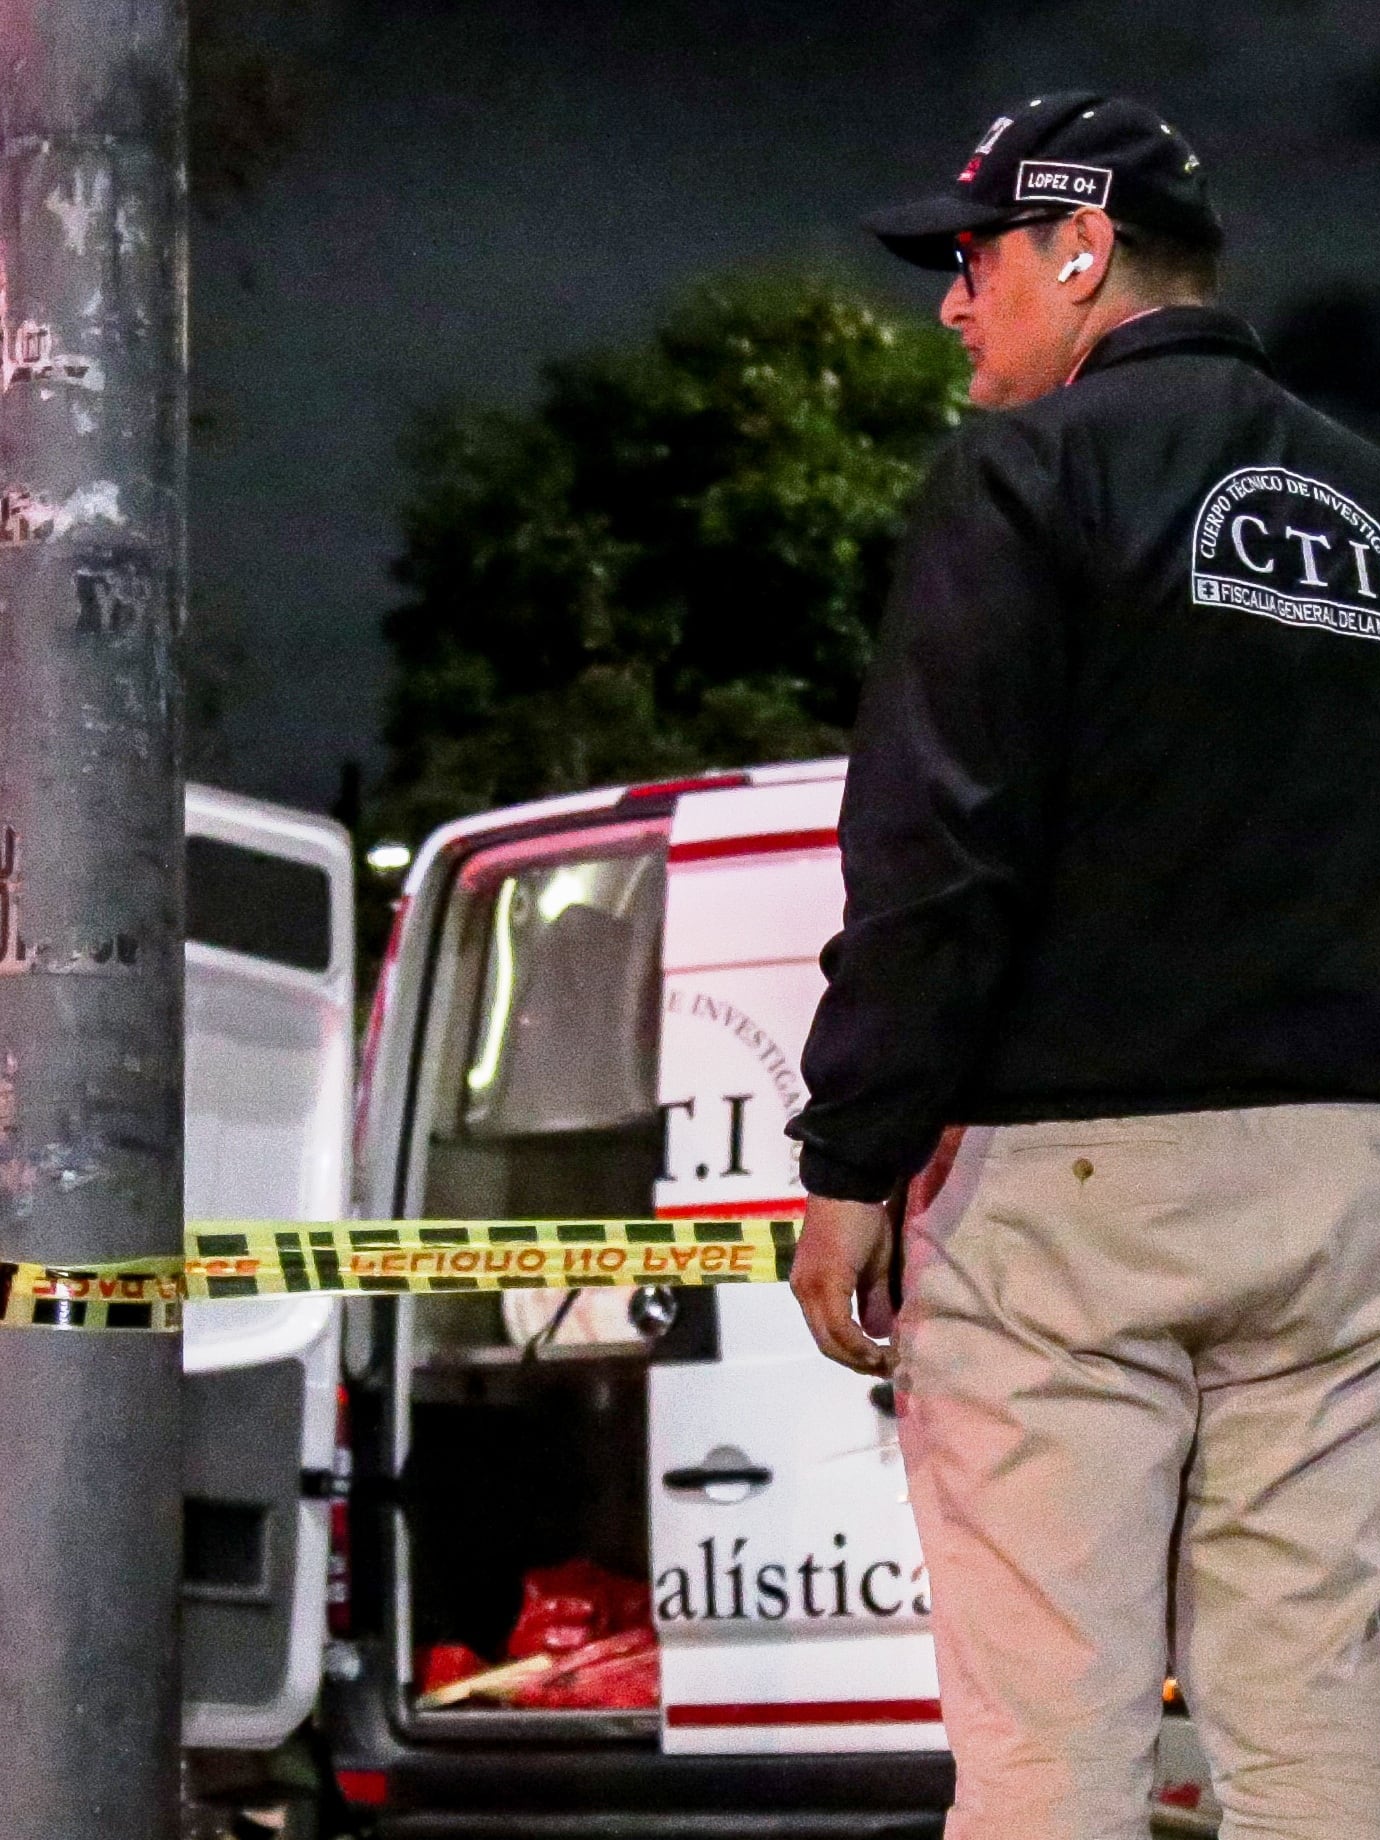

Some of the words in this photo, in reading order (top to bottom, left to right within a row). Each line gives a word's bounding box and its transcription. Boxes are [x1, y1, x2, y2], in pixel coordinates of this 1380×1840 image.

[1028, 172, 1069, 190] LOPEZ
[1200, 496, 1231, 558] CUERPO
[1285, 479, 1310, 497] DE
[1338, 610, 1357, 630] DE
[1358, 614, 1376, 633] LA
